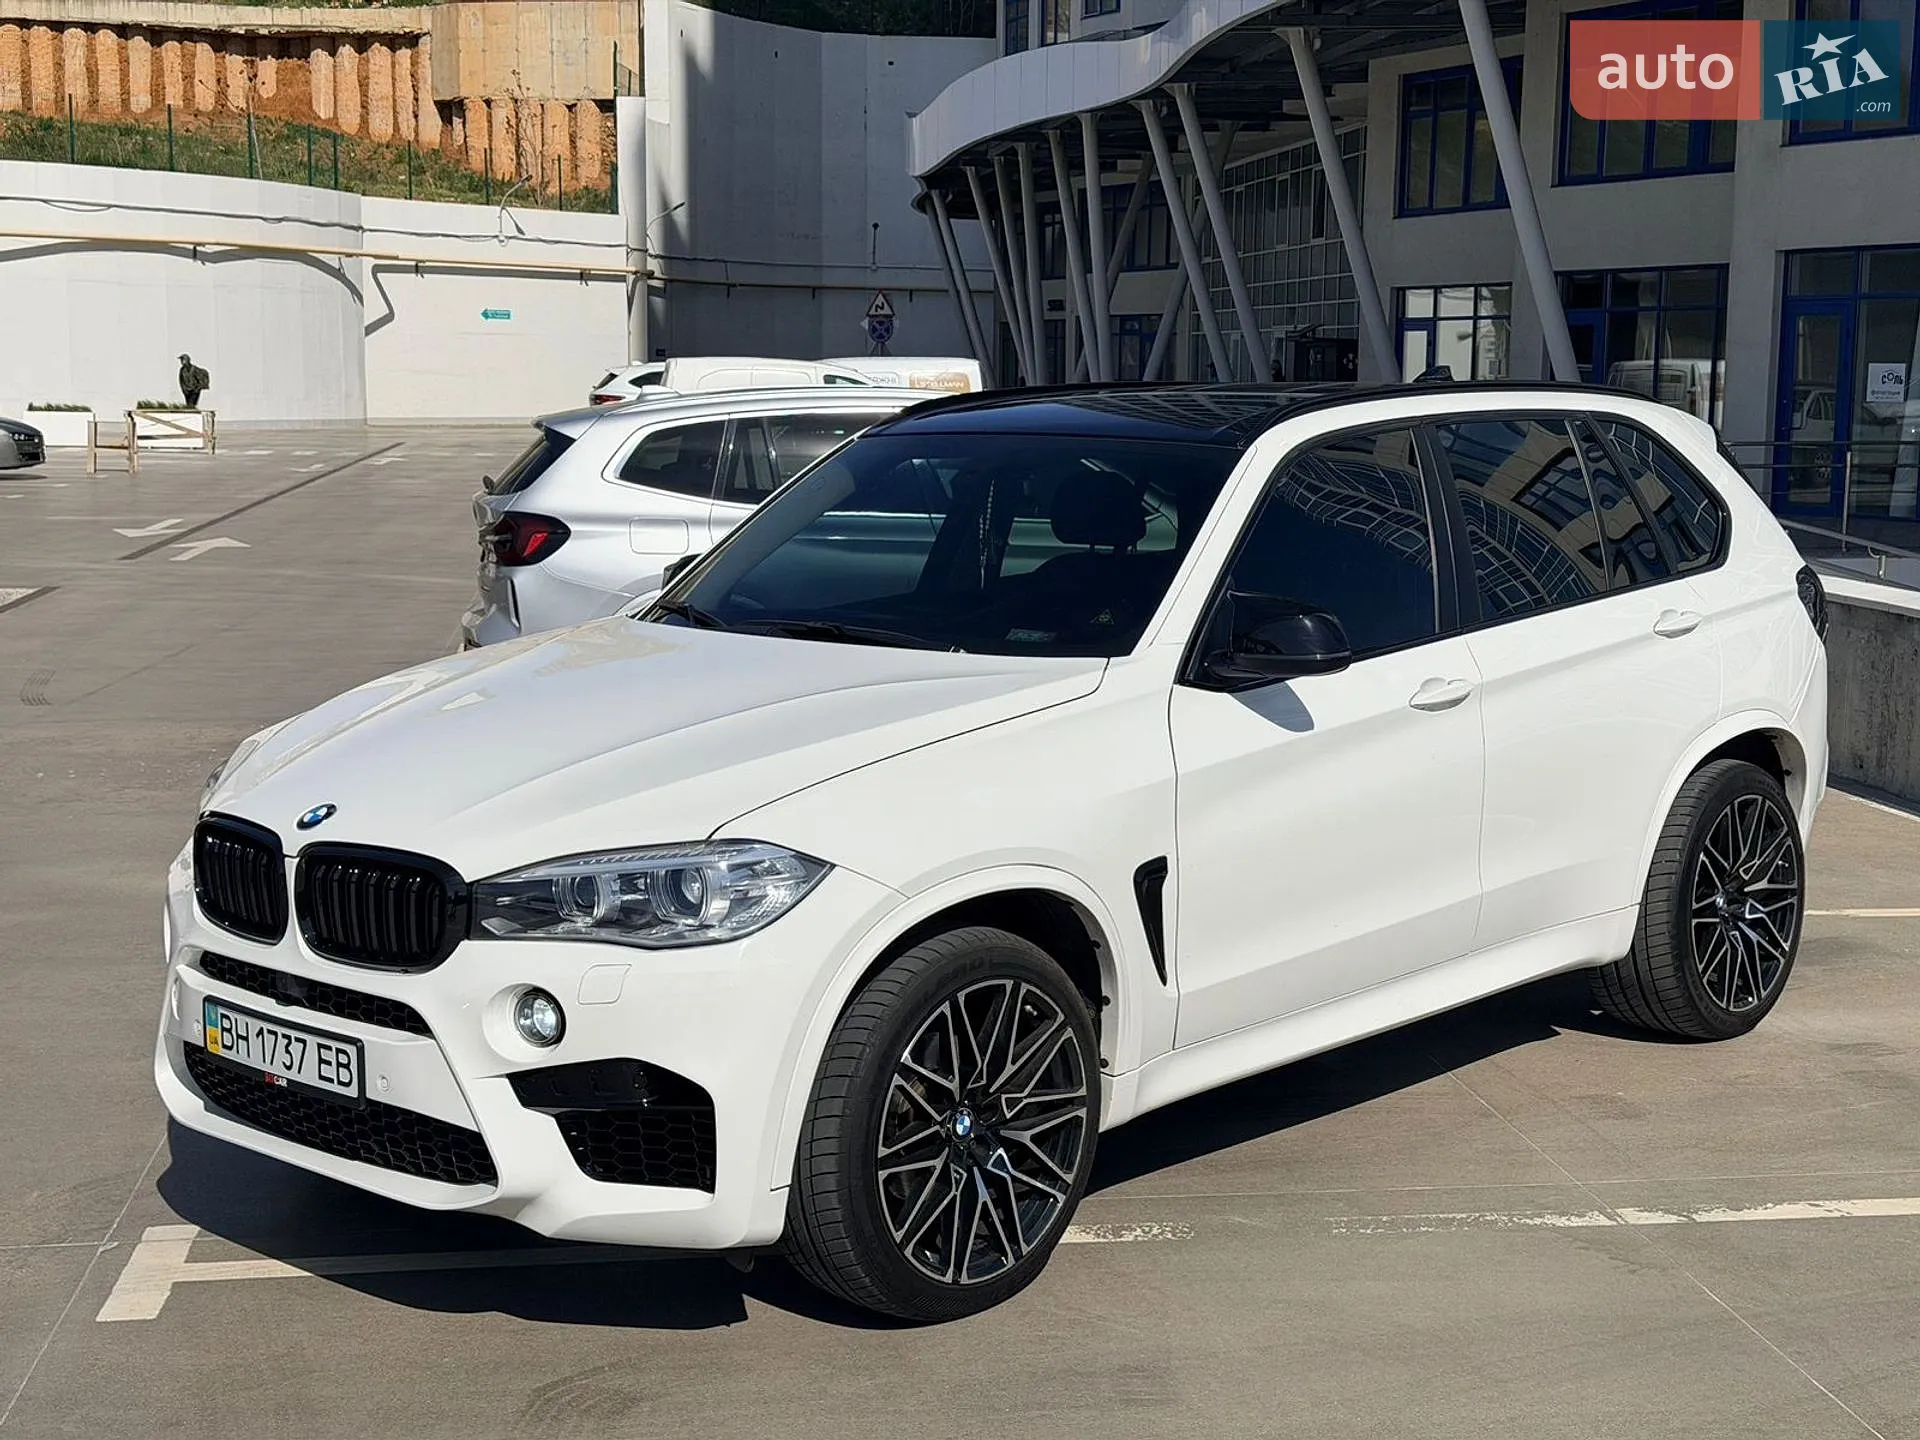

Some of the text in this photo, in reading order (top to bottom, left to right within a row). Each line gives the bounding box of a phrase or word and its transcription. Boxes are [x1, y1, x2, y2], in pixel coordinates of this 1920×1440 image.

[220, 1012, 353, 1087] BH 1737 EB
